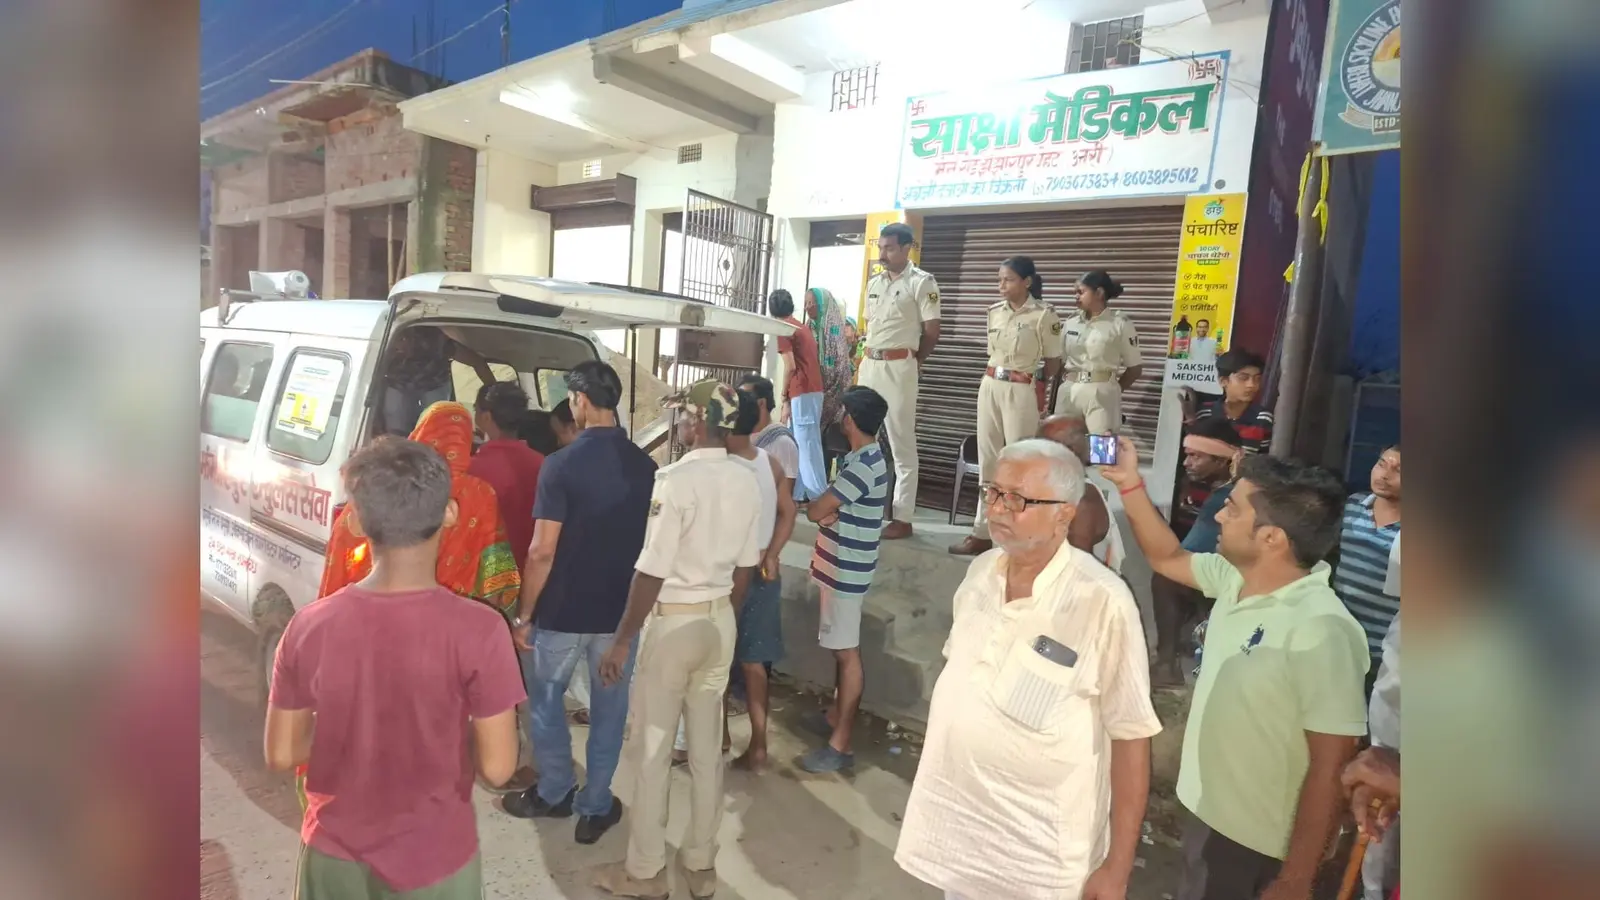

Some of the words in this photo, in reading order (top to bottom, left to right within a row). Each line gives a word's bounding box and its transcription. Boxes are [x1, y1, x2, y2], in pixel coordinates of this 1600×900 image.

[1028, 84, 1216, 144] मेडिकल
[1176, 362, 1215, 372] SAKSHI
[1171, 372, 1217, 383] MEDICAL
